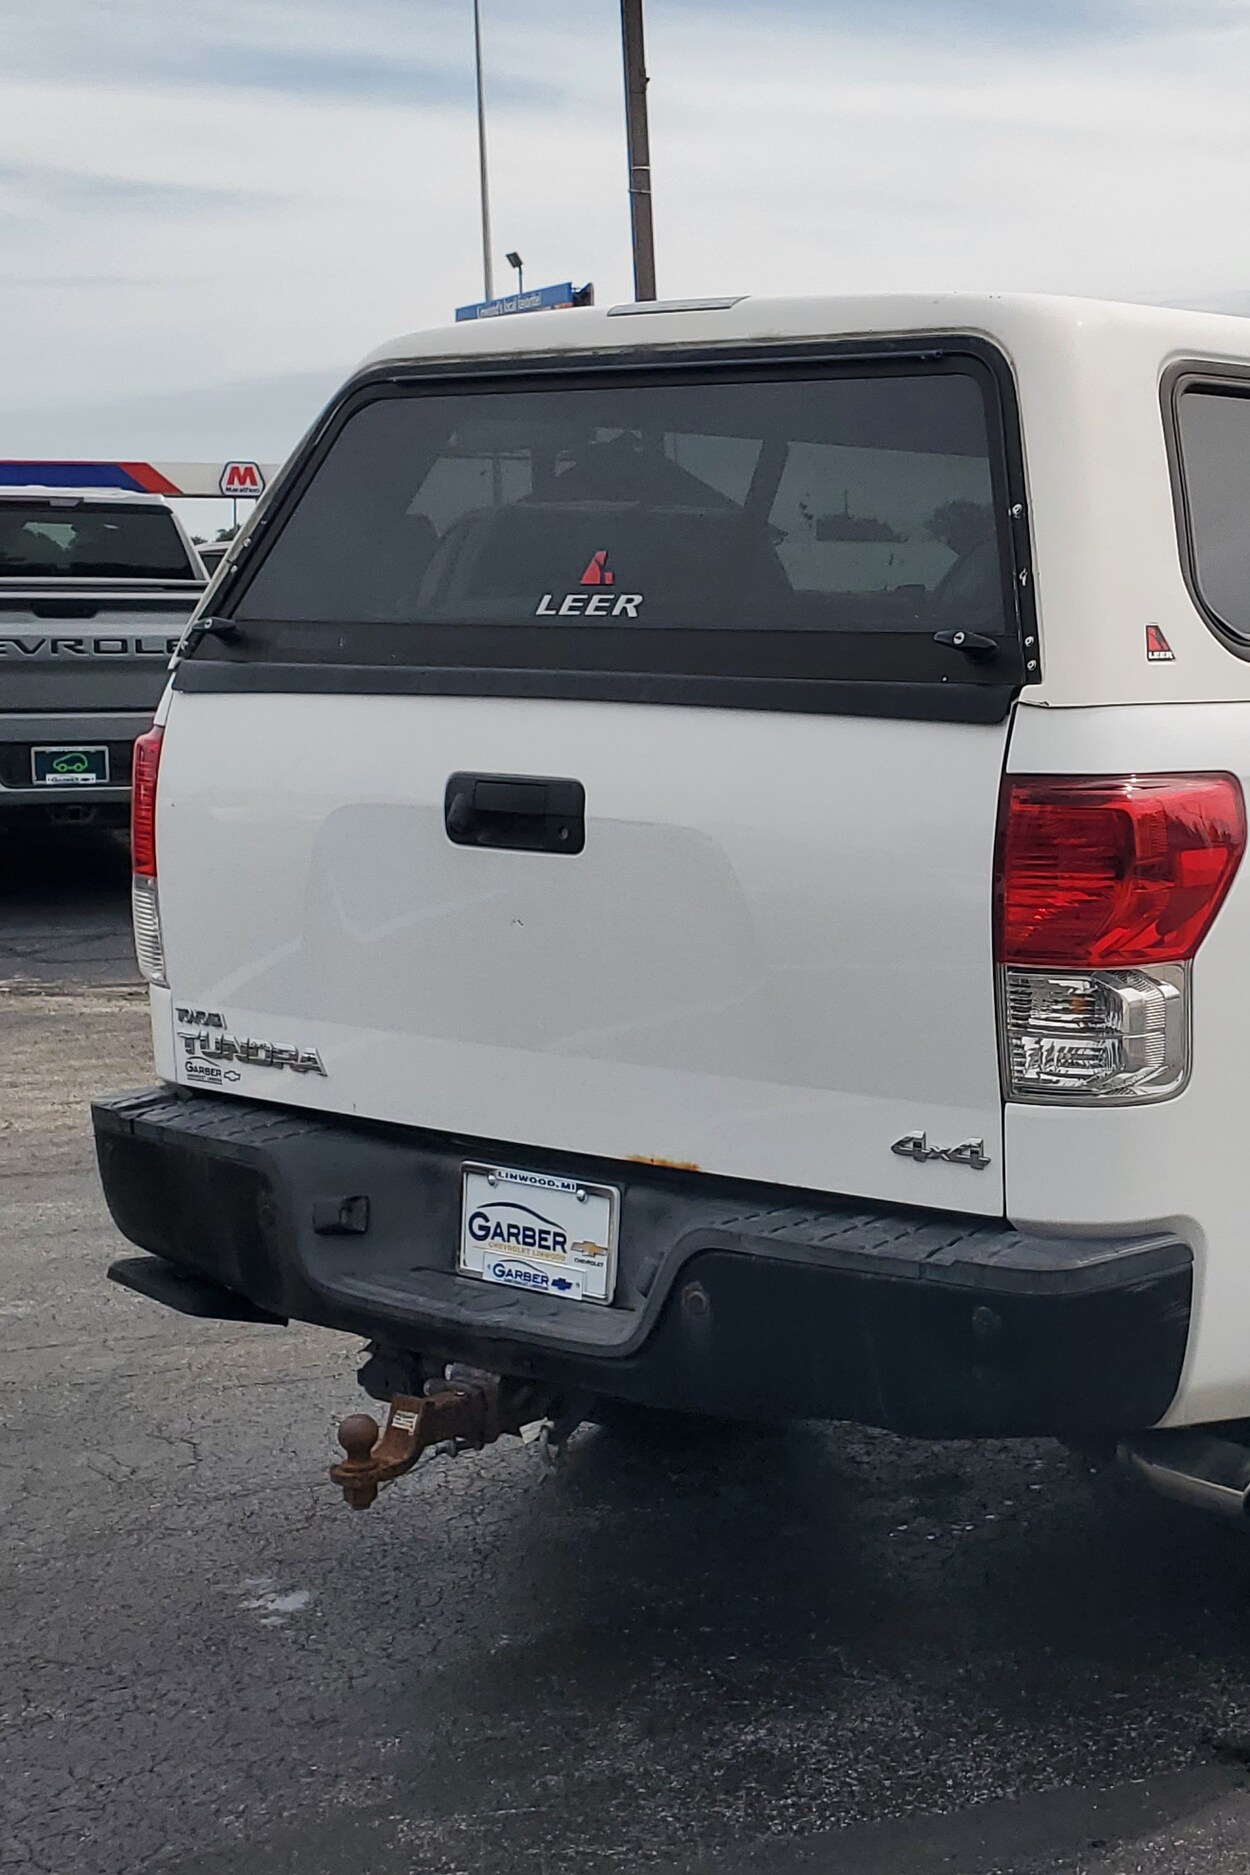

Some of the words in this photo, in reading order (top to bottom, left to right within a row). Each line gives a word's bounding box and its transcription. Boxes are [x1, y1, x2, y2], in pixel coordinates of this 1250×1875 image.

[535, 594, 643, 618] LEER
[1148, 651, 1174, 660] LEER
[177, 1030, 328, 1077] TUNDRA
[185, 1061, 222, 1077] GARBER
[468, 1211, 568, 1254] GARBER
[492, 1263, 550, 1287] GARBER
